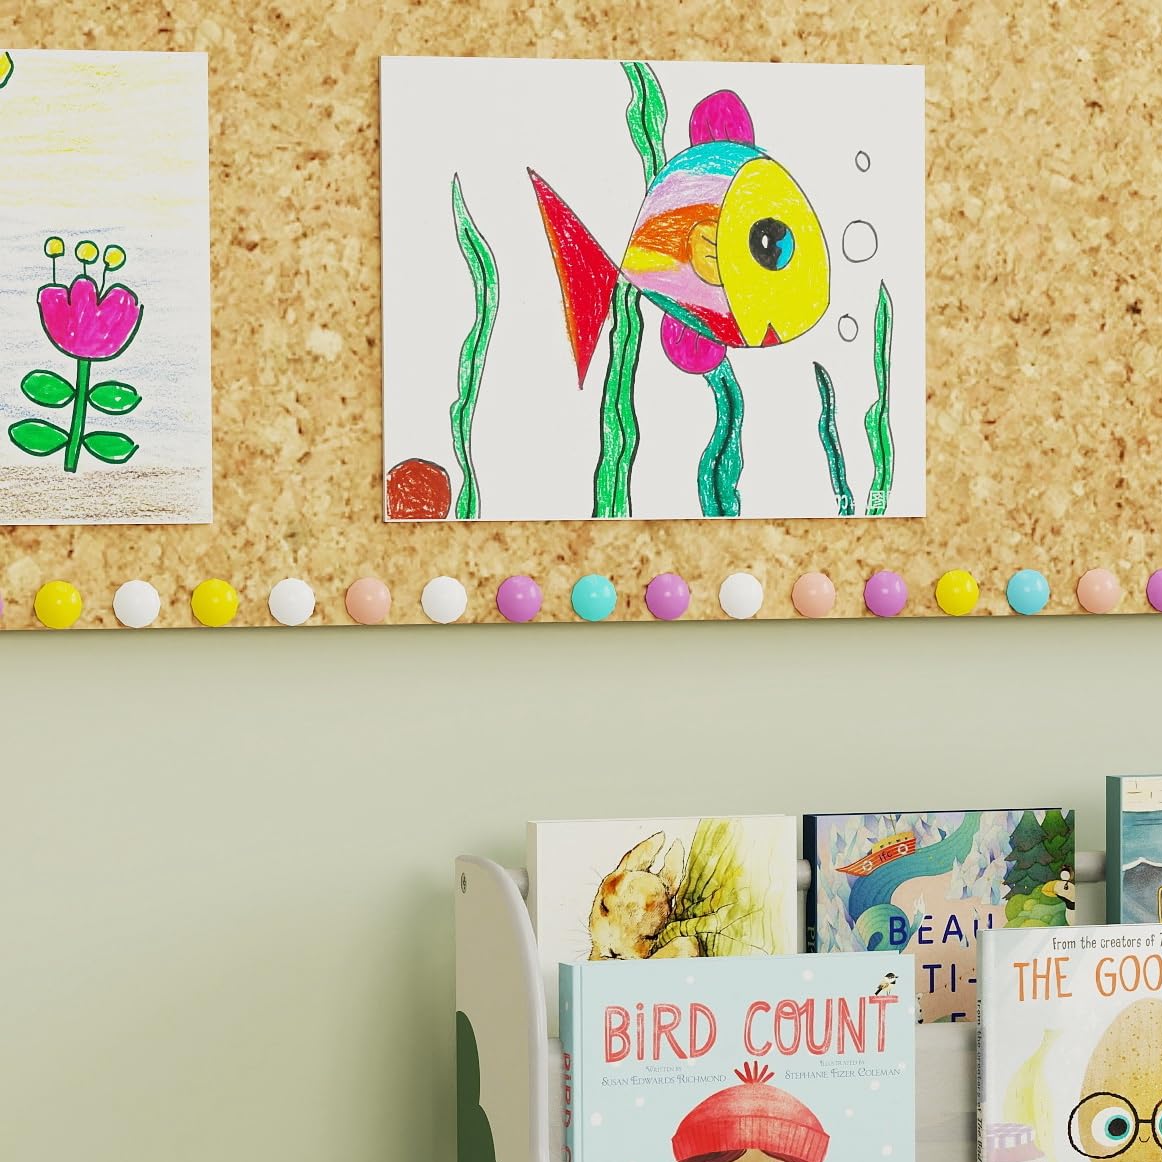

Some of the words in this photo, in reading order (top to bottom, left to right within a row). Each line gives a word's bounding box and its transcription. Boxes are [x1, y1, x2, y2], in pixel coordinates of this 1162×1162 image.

[1052, 937, 1076, 950] From
[1080, 936, 1097, 949] the
[1100, 935, 1142, 949] creators
[1145, 933, 1156, 947] of
[1013, 957, 1073, 1001] THE
[743, 994, 899, 1057] COUNT
[601, 1076, 629, 1087] SUSAN
[630, 1075, 675, 1086] EDWARDS
[676, 1074, 727, 1083] RICHMOND
[784, 1070, 829, 1080] STEPHANIE
[857, 1067, 901, 1077] COLEMAN
